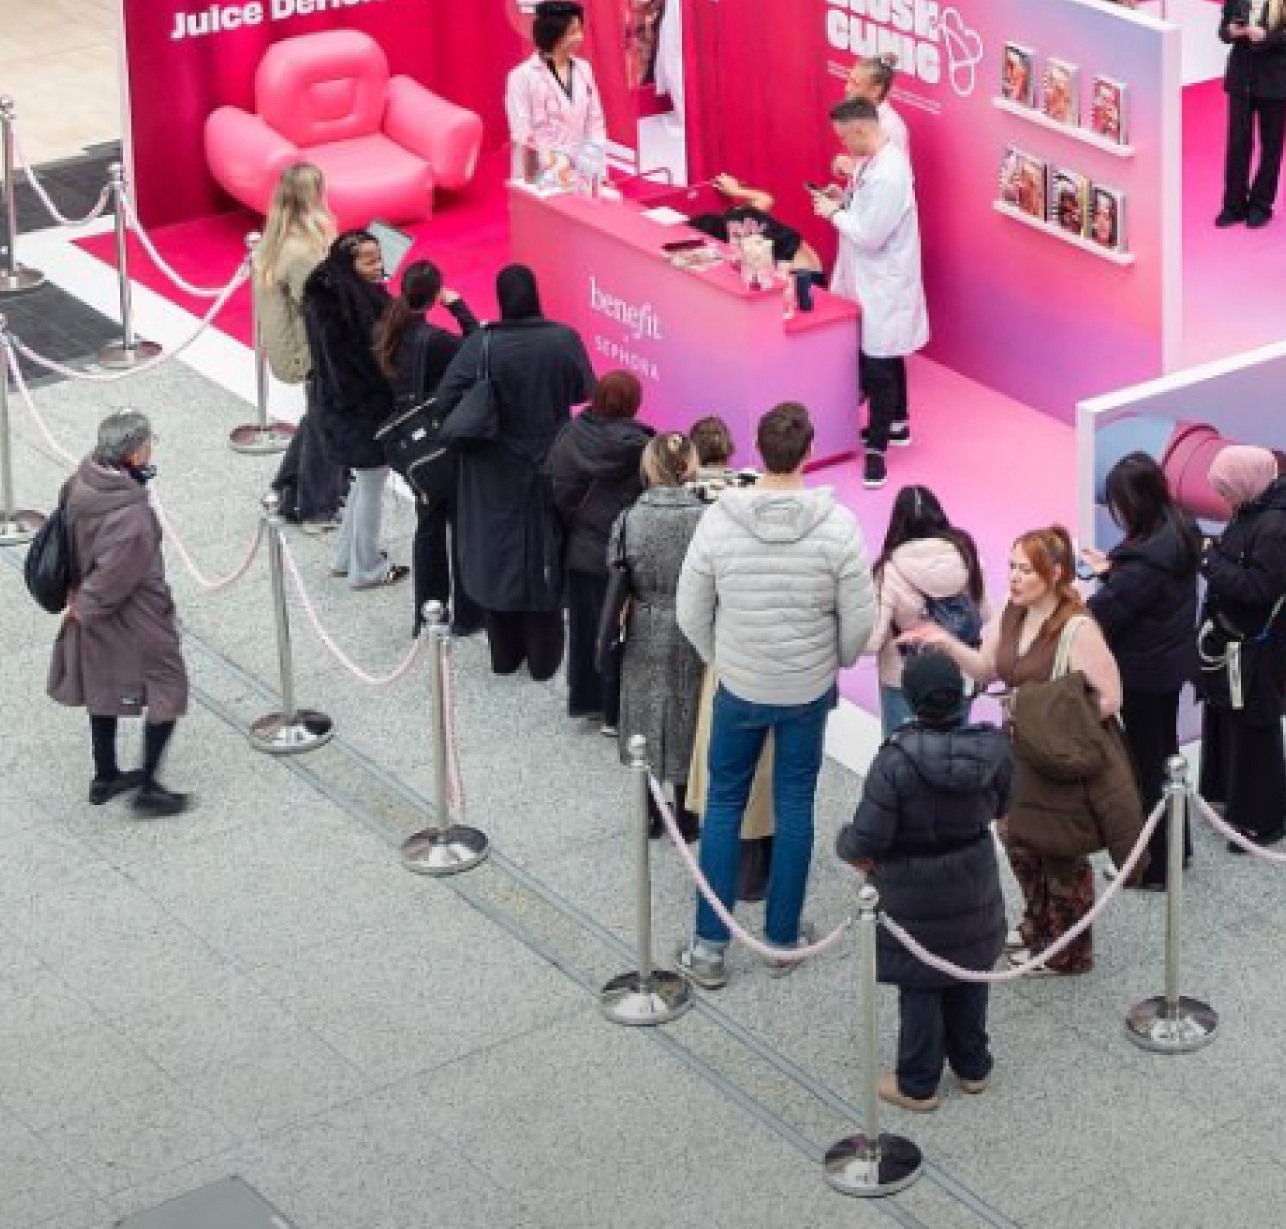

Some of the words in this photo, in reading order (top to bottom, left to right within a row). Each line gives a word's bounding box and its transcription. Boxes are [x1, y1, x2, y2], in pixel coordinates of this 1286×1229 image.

[171, 1, 263, 39] Juice
[588, 276, 663, 340] benefit
[594, 335, 660, 381] SEPHORA
